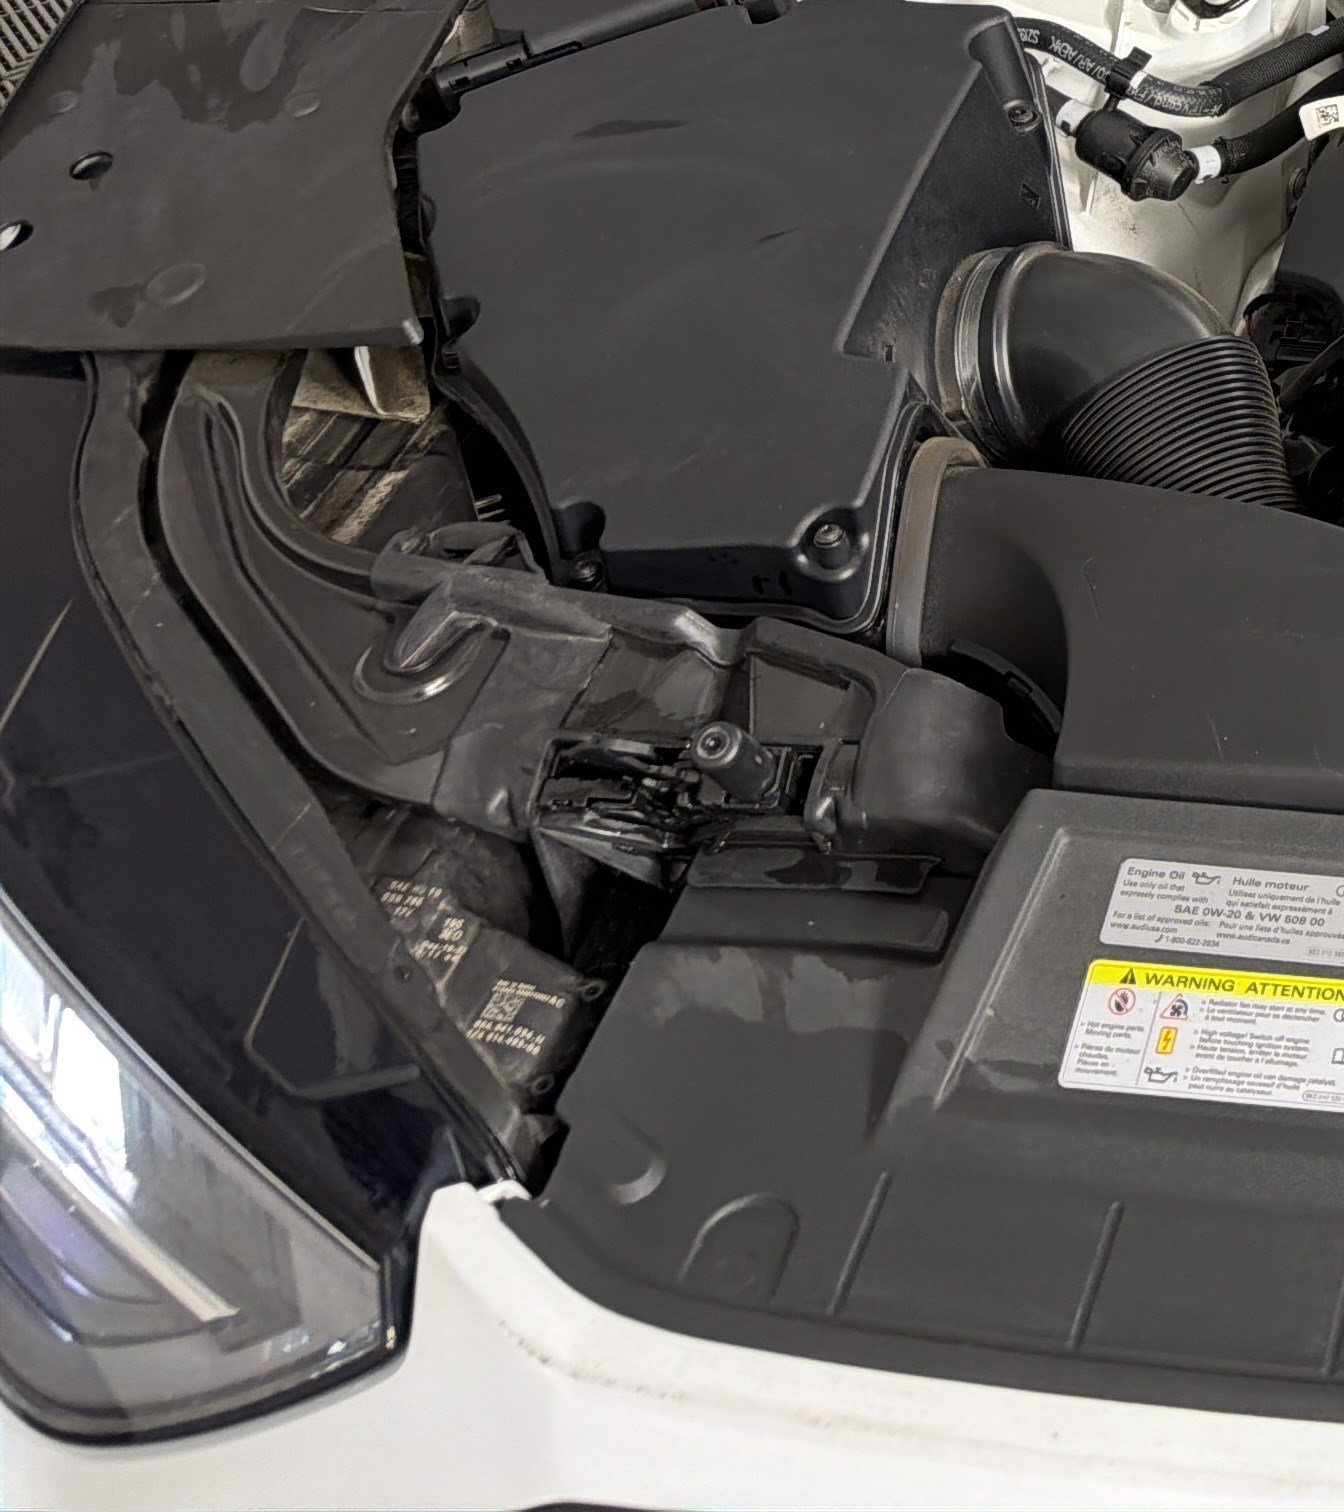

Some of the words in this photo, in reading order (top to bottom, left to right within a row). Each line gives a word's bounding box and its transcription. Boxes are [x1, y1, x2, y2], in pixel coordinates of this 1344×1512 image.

[1125, 866, 1167, 879] Engine
[1168, 870, 1186, 880] Oil
[1231, 876, 1262, 887] Huile
[1263, 879, 1310, 891] moteur
[1173, 904, 1200, 915] SAE
[1201, 906, 1242, 919] 0W-20
[1244, 910, 1255, 920] &
[1257, 911, 1282, 922] VW
[1308, 916, 1326, 927] 00
[1143, 972, 1236, 992] WARNING
